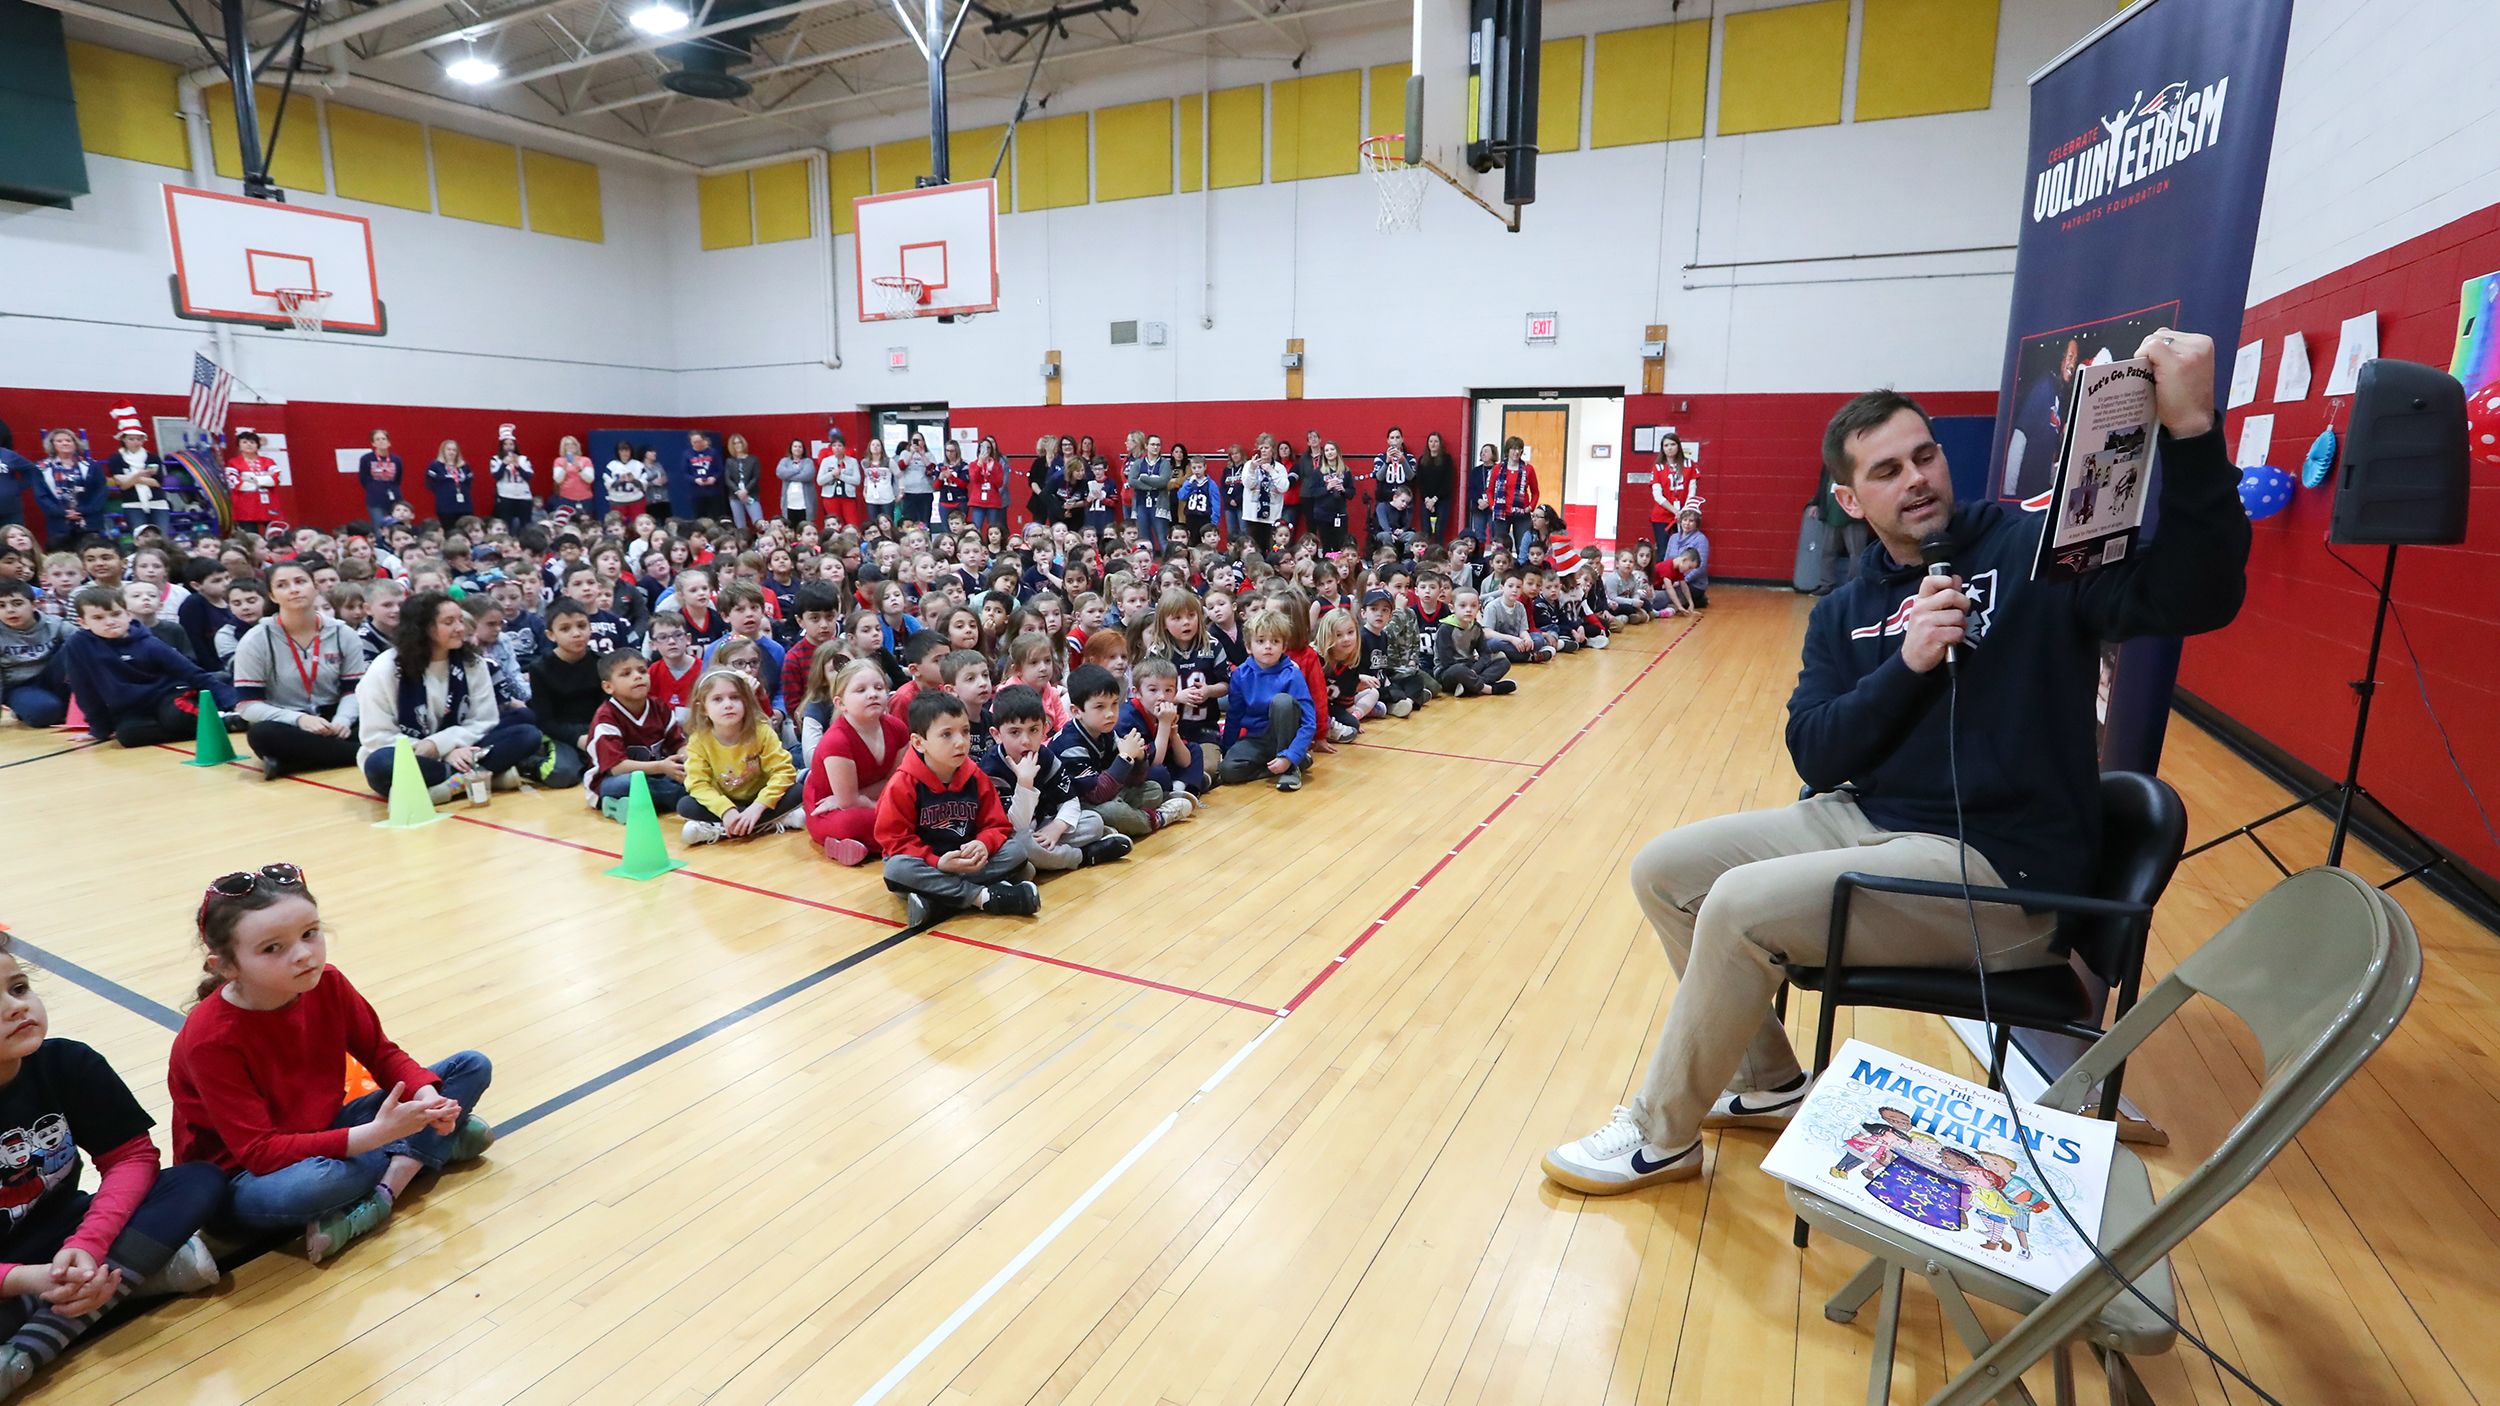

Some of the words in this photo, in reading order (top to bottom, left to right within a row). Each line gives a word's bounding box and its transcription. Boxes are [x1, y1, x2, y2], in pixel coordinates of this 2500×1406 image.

[2033, 76, 2229, 223] VOLUNTEERISM
[2048, 127, 2099, 164] CELEBRATE
[2061, 207, 2103, 232] PATRIOTS
[2106, 179, 2170, 214] FOUNDATION
[1532, 319, 1553, 336] EXIT
[2088, 376, 2109, 397] Let's
[1386, 463, 1406, 484] 80
[1188, 493, 1207, 512] 83
[919, 801, 978, 826] ATRIOT
[1900, 1062, 1968, 1092] MALCOLM
[1949, 1087, 1975, 1103] THE
[1851, 1058, 2081, 1165] MAGICIAN'S
[1911, 1106, 1993, 1150] HAT
